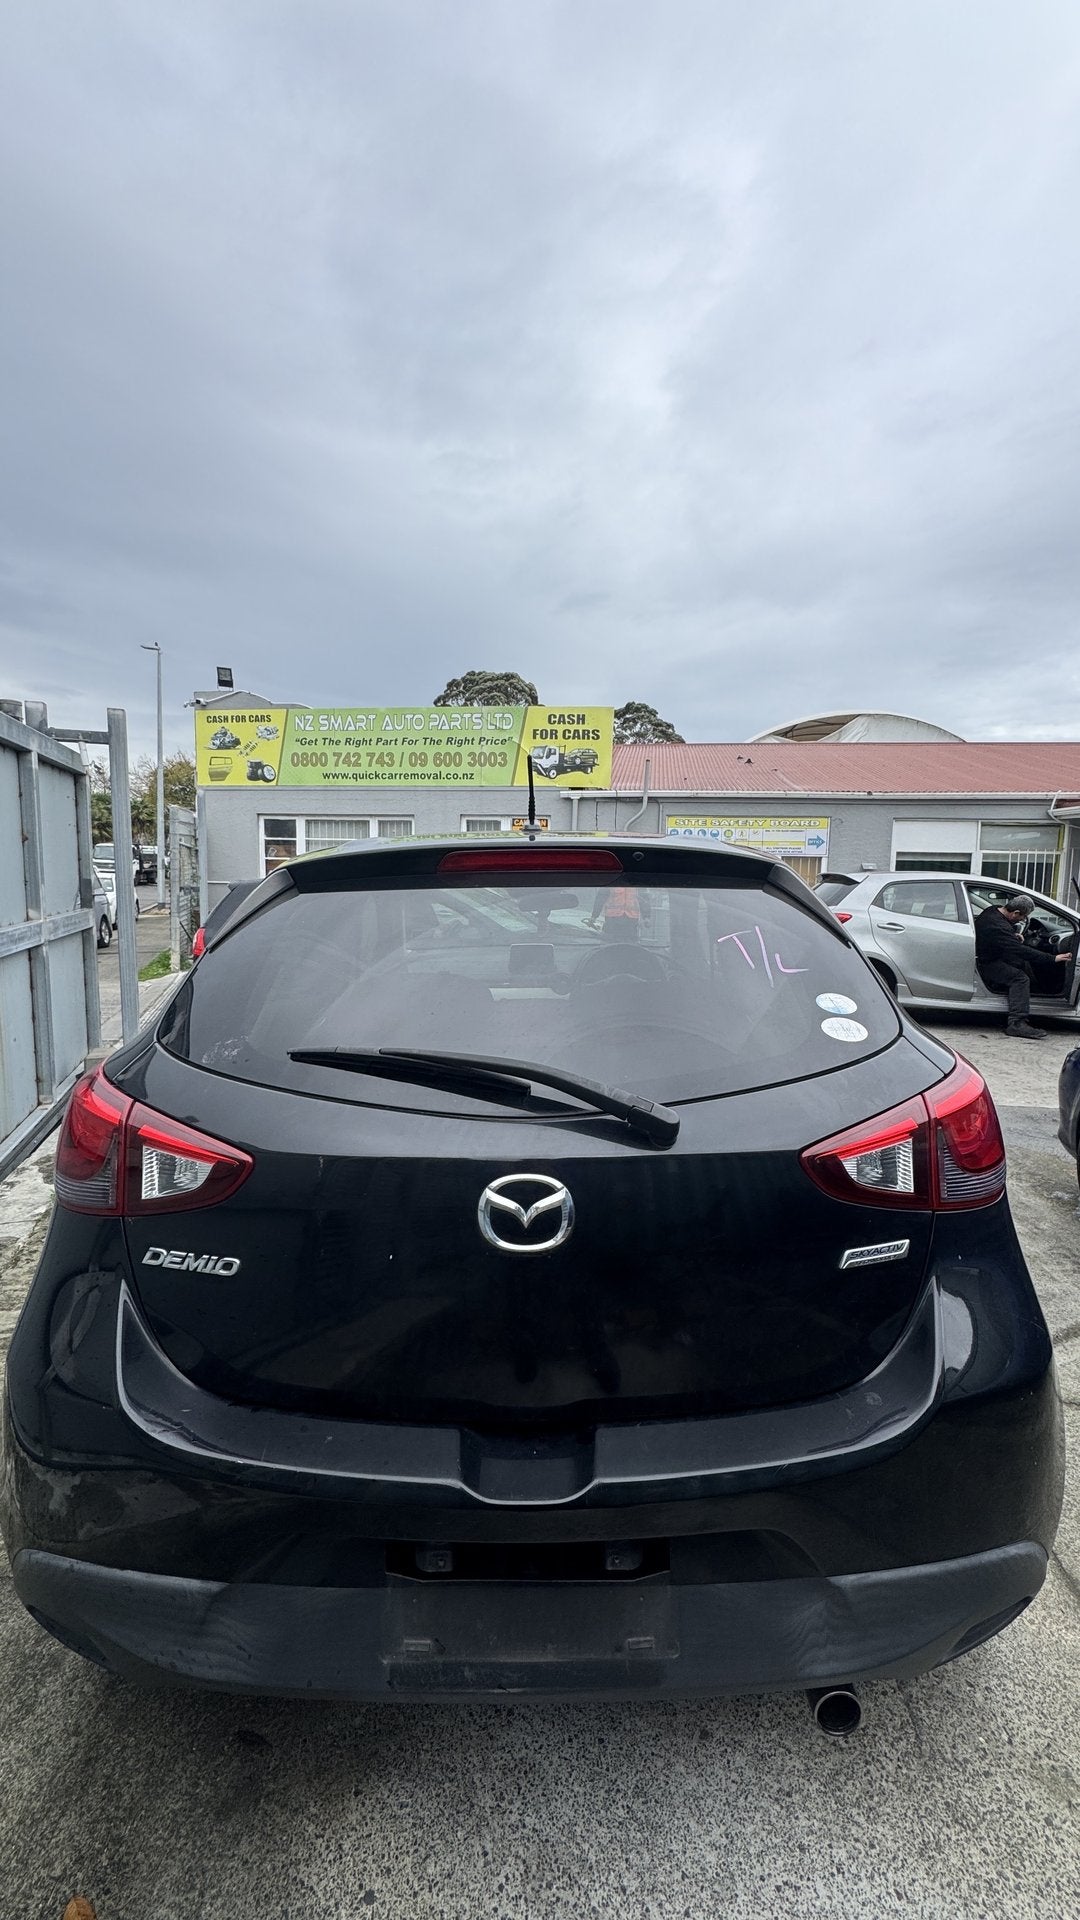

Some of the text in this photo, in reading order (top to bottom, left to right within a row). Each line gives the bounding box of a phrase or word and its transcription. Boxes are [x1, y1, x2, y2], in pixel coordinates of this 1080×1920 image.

[206, 714, 272, 724] CASH FOR CARS
[294, 713, 514, 731] NZ SMART AUTO PARTS LTD
[548, 714, 585, 725] CASH
[532, 729, 600, 740] FOR CARS
[322, 738, 341, 746] The
[344, 738, 373, 748] Right
[375, 738, 399, 746] Part
[401, 737, 419, 746] For
[423, 737, 442, 746] The
[446, 737, 477, 747] Right
[290, 752, 508, 768] 0800 742 743 / 09 600 3003
[322, 771, 475, 780] www.quickcarremoval.co.nz
[849, 1243, 906, 1259] SKYACTIV
[141, 1246, 241, 1277] DEMIO
